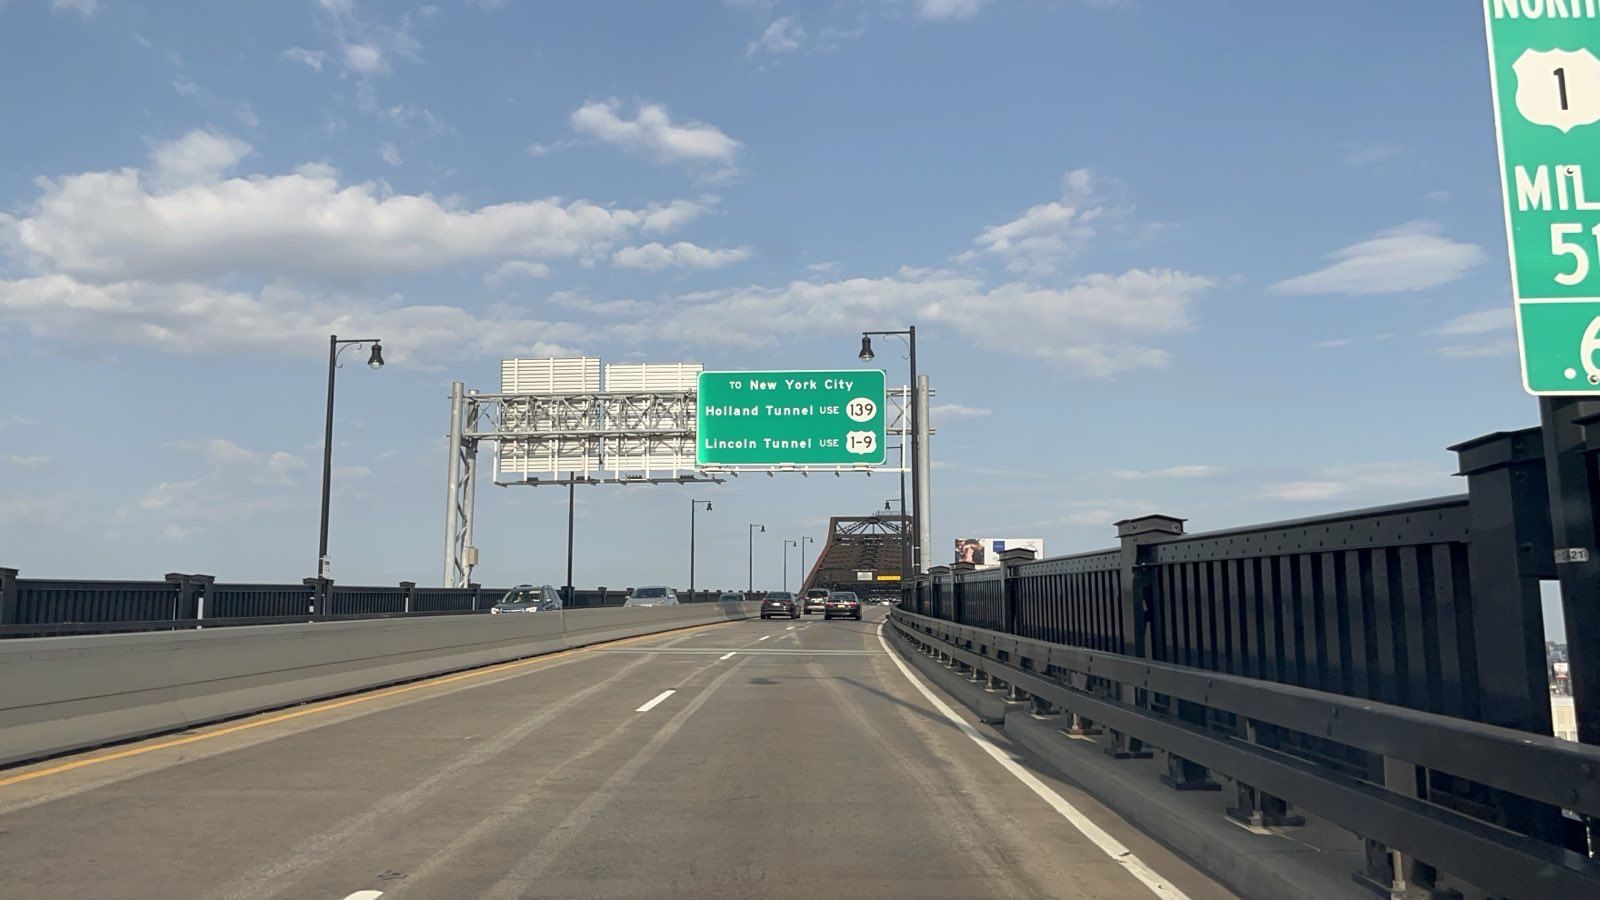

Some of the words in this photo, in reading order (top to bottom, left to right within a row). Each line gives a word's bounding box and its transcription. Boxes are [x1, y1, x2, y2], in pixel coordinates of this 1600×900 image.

[1552, 67, 1569, 111] 1
[729, 381, 742, 390] TO
[749, 380, 777, 390] New
[785, 379, 817, 390] York
[824, 379, 854, 392] City
[705, 405, 759, 416] Holland
[765, 405, 814, 416] Tunnel
[819, 406, 840, 415] USE
[849, 403, 874, 416] 139
[705, 438, 757, 449] Lincoln
[763, 438, 812, 449] Tunnel
[819, 439, 840, 447] USE
[850, 436, 873, 448] 1-9
